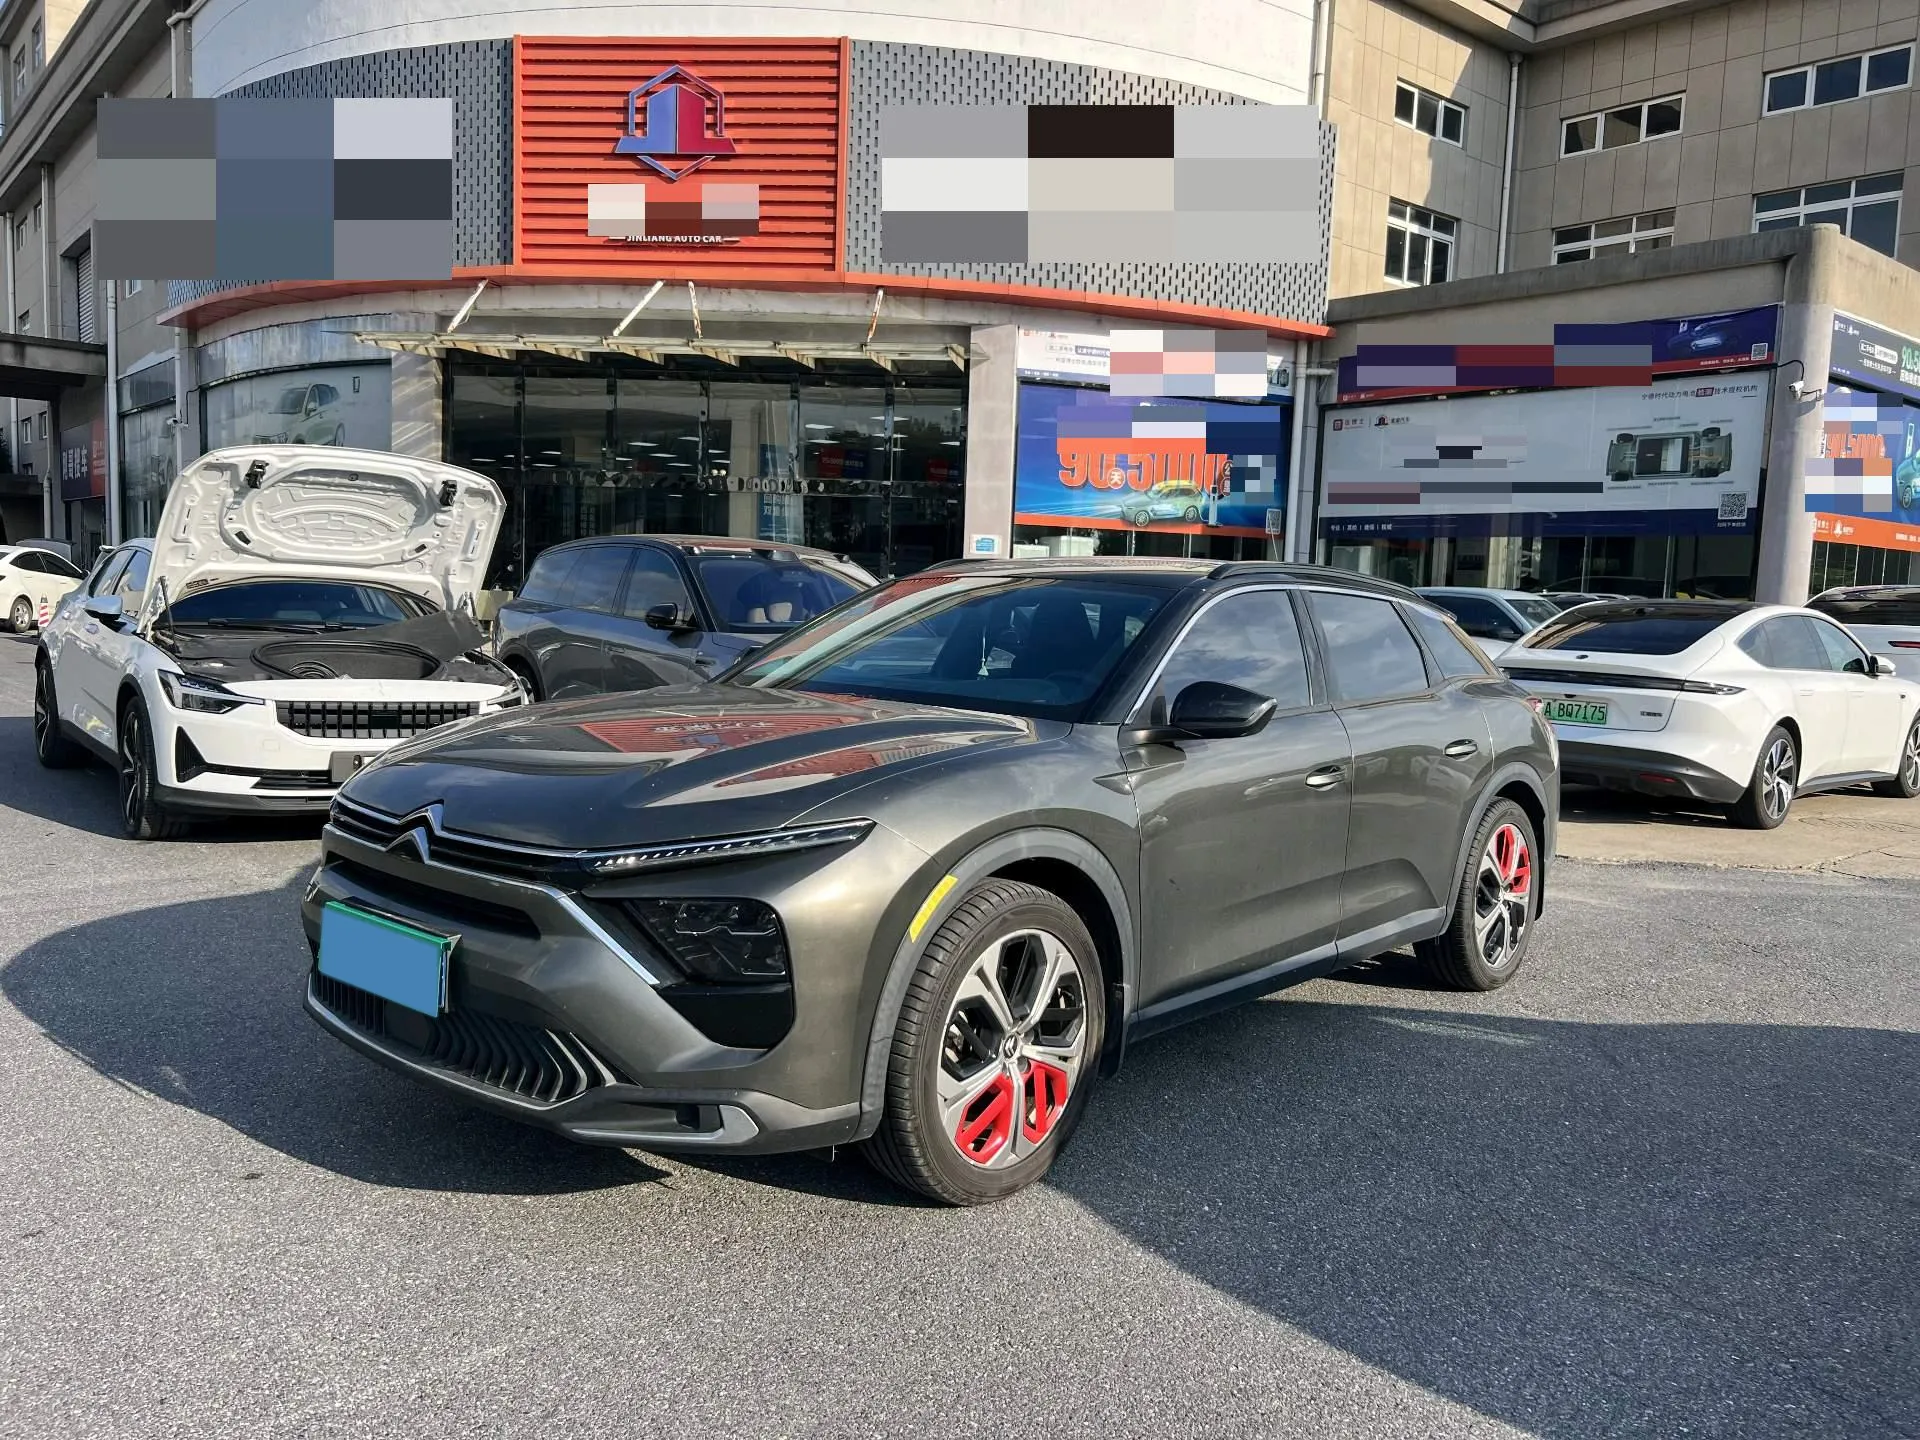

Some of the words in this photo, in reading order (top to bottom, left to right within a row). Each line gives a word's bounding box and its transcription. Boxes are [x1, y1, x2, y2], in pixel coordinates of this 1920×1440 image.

[674, 235, 701, 243] AUTO
[703, 235, 722, 243] CAR
[1557, 702, 1606, 722] BQ7175
